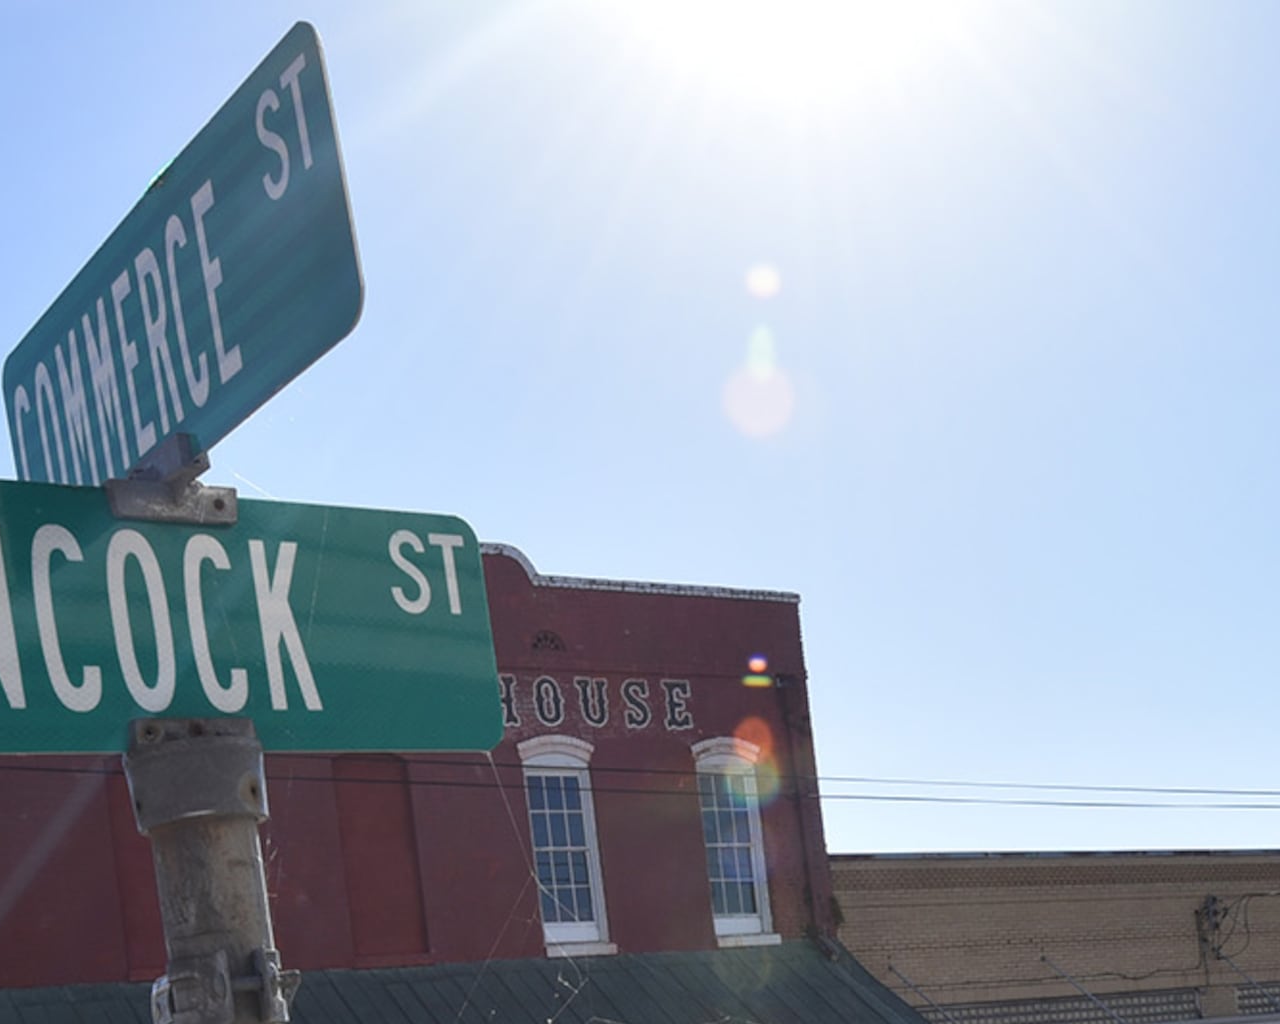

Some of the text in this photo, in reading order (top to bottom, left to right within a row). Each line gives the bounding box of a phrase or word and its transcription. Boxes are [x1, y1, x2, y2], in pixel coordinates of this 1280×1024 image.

[14, 53, 314, 487] COMMERCE ST
[388, 529, 466, 616] ST
